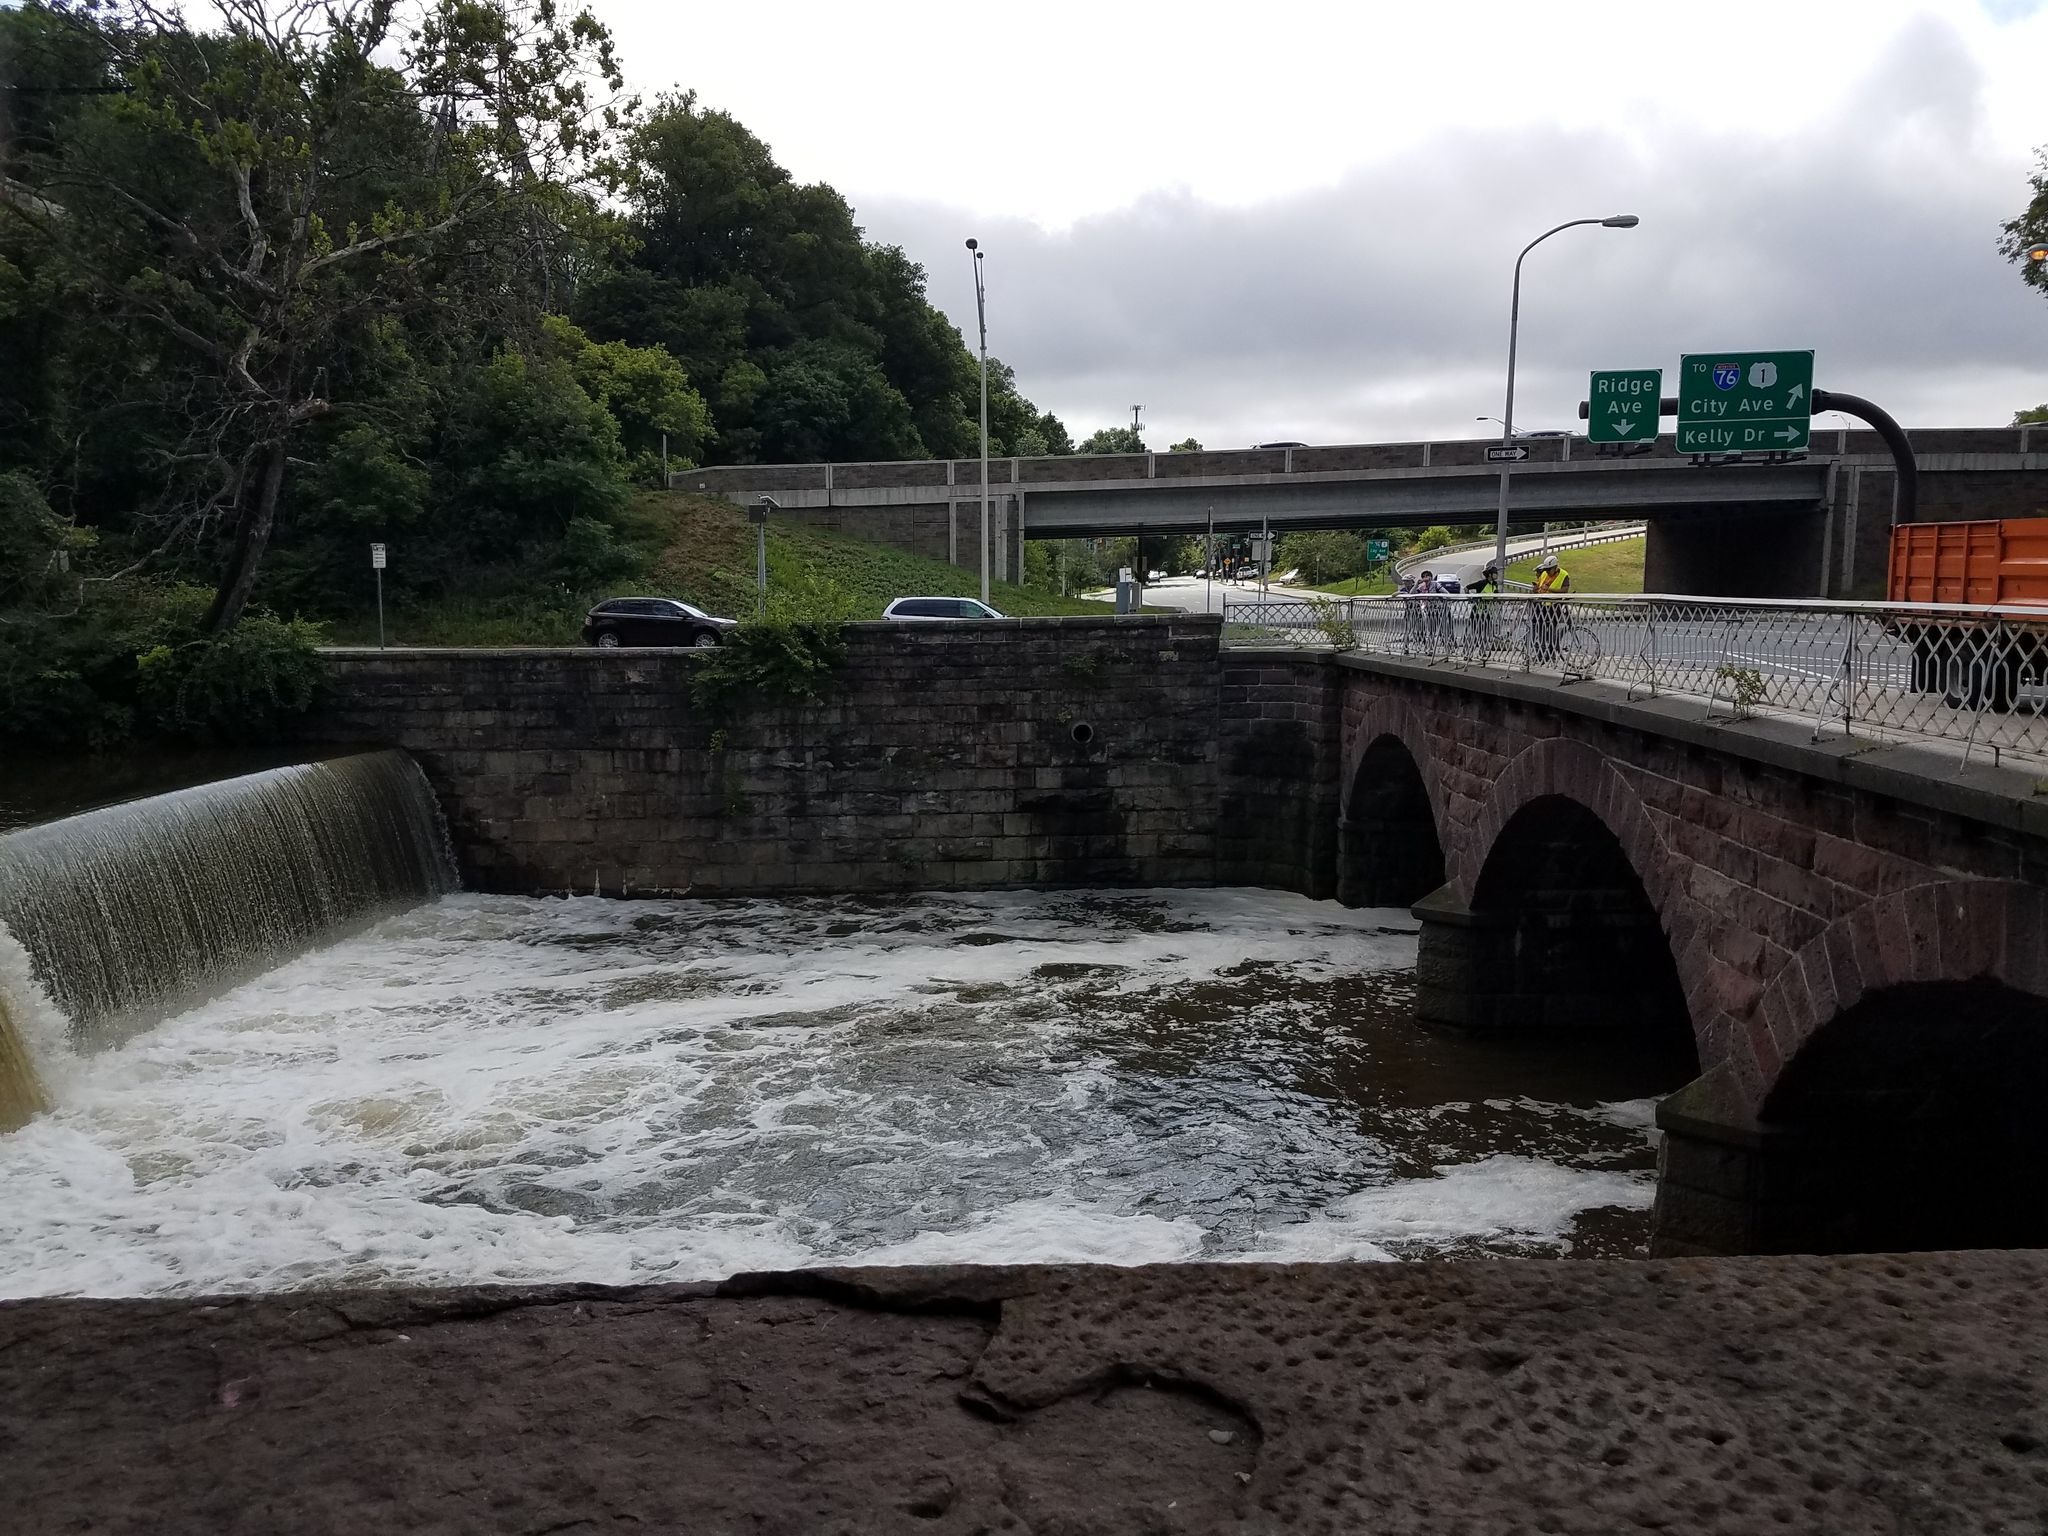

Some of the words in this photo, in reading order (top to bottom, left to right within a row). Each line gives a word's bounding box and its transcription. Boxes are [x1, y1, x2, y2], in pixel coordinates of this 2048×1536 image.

[1692, 363, 1707, 373] TO
[1716, 370, 1737, 385] 76
[1760, 368, 1766, 383] 1
[1598, 377, 1654, 396] Ridge
[1607, 400, 1643, 414] Ave
[1690, 398, 1728, 416] City
[1738, 398, 1774, 412] Ave
[1684, 428, 1734, 446] Kelly
[1744, 428, 1766, 442] Dr
